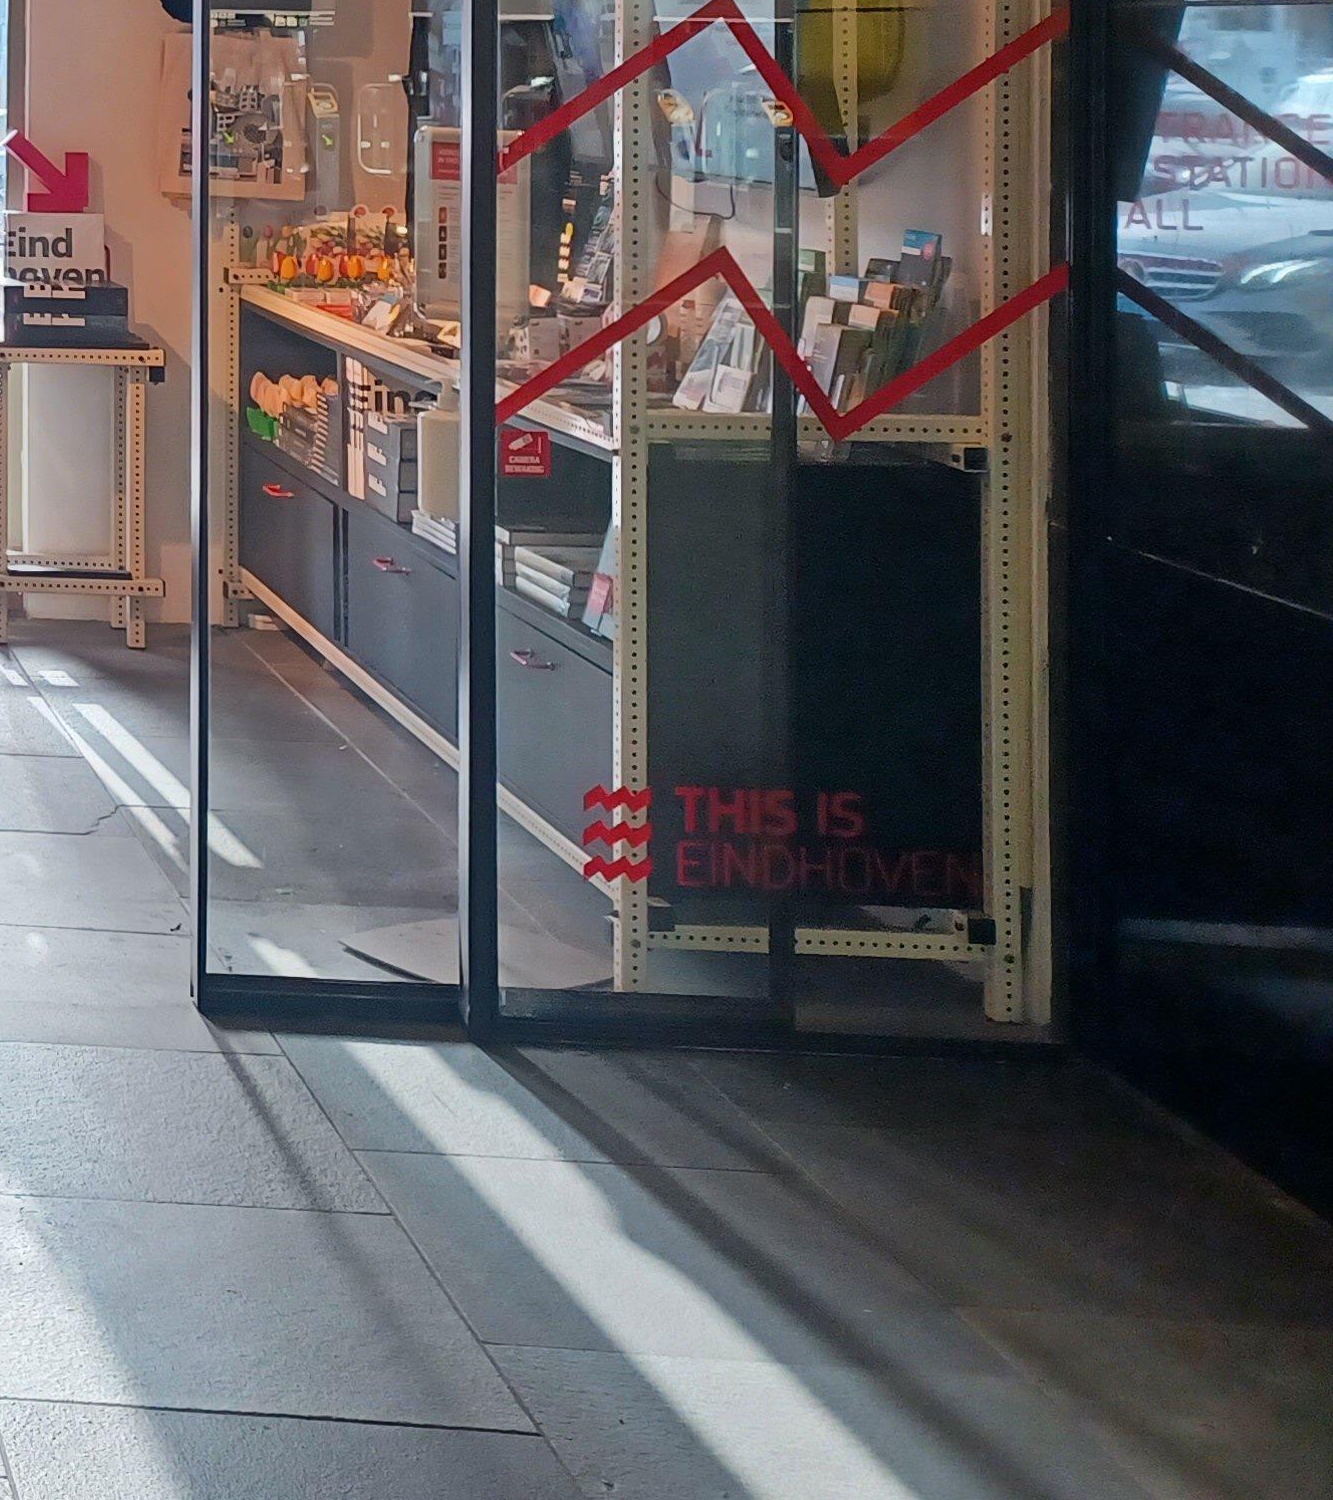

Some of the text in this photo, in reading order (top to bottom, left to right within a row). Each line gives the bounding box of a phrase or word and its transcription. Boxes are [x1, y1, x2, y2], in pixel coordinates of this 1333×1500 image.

[7, 226, 73, 258] Eind
[675, 785, 866, 838] THIS IS
